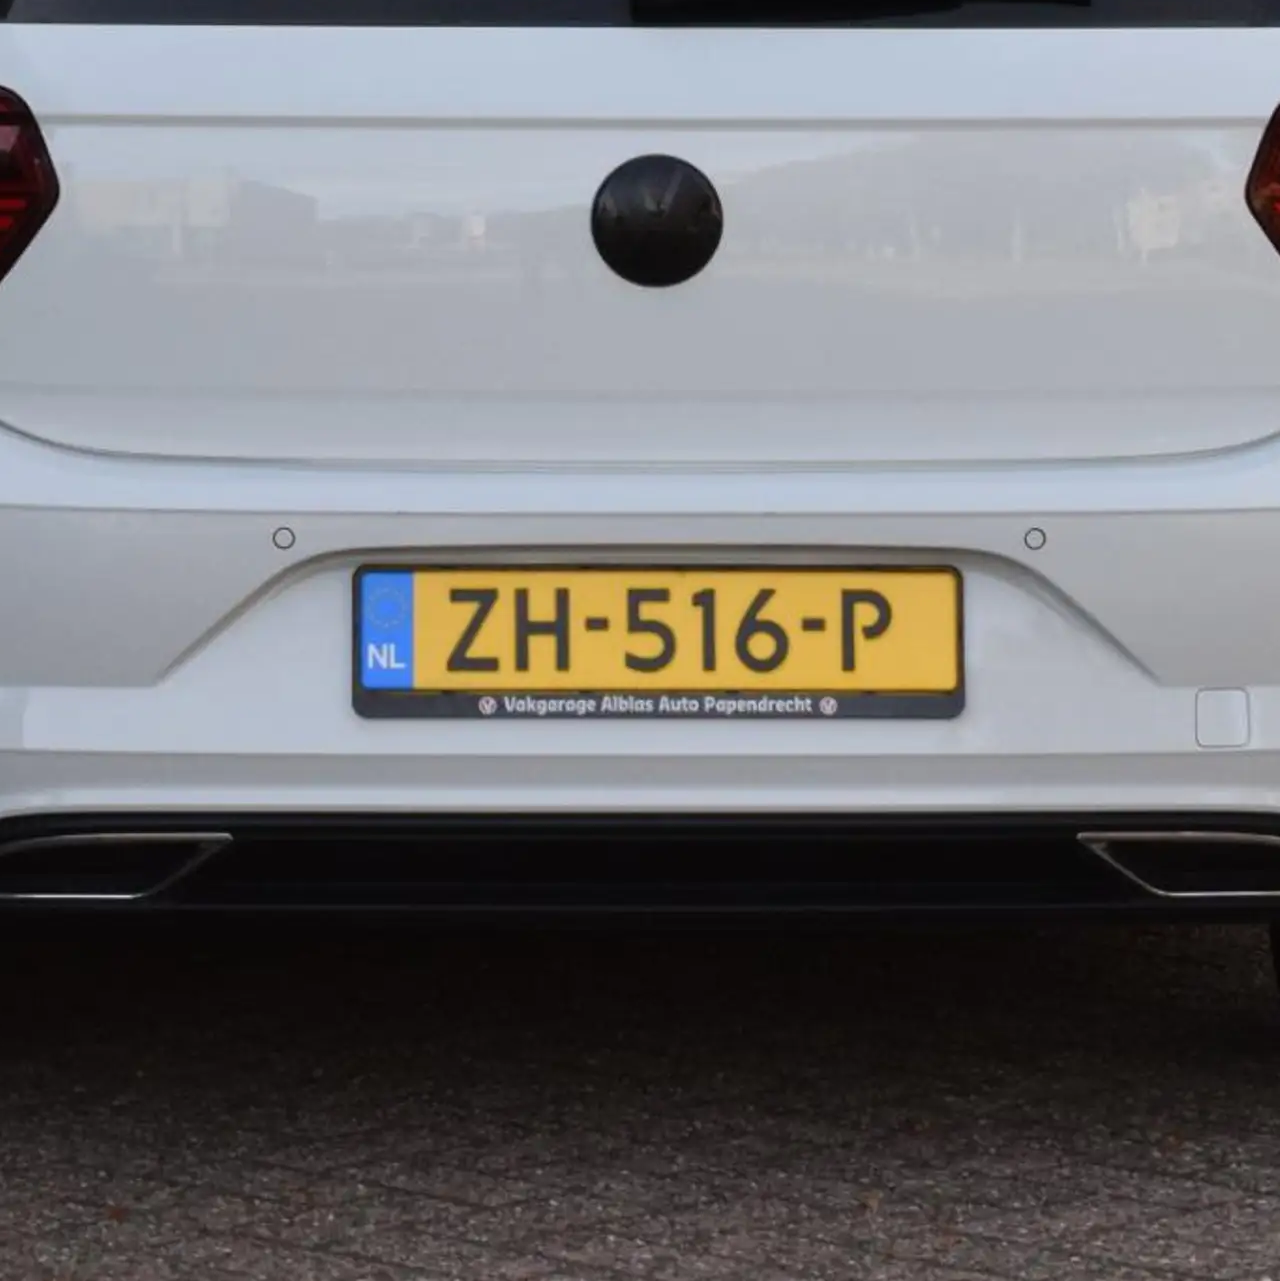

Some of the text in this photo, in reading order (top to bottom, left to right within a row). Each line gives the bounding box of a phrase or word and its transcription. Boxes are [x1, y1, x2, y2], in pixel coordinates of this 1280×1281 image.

[446, 587, 893, 672] ZH-516-P
[366, 644, 406, 670] NL
[504, 696, 597, 716] Vakgarage
[600, 695, 654, 713] Alblas
[658, 696, 700, 713] Auto
[704, 695, 813, 716] Papendrecht
